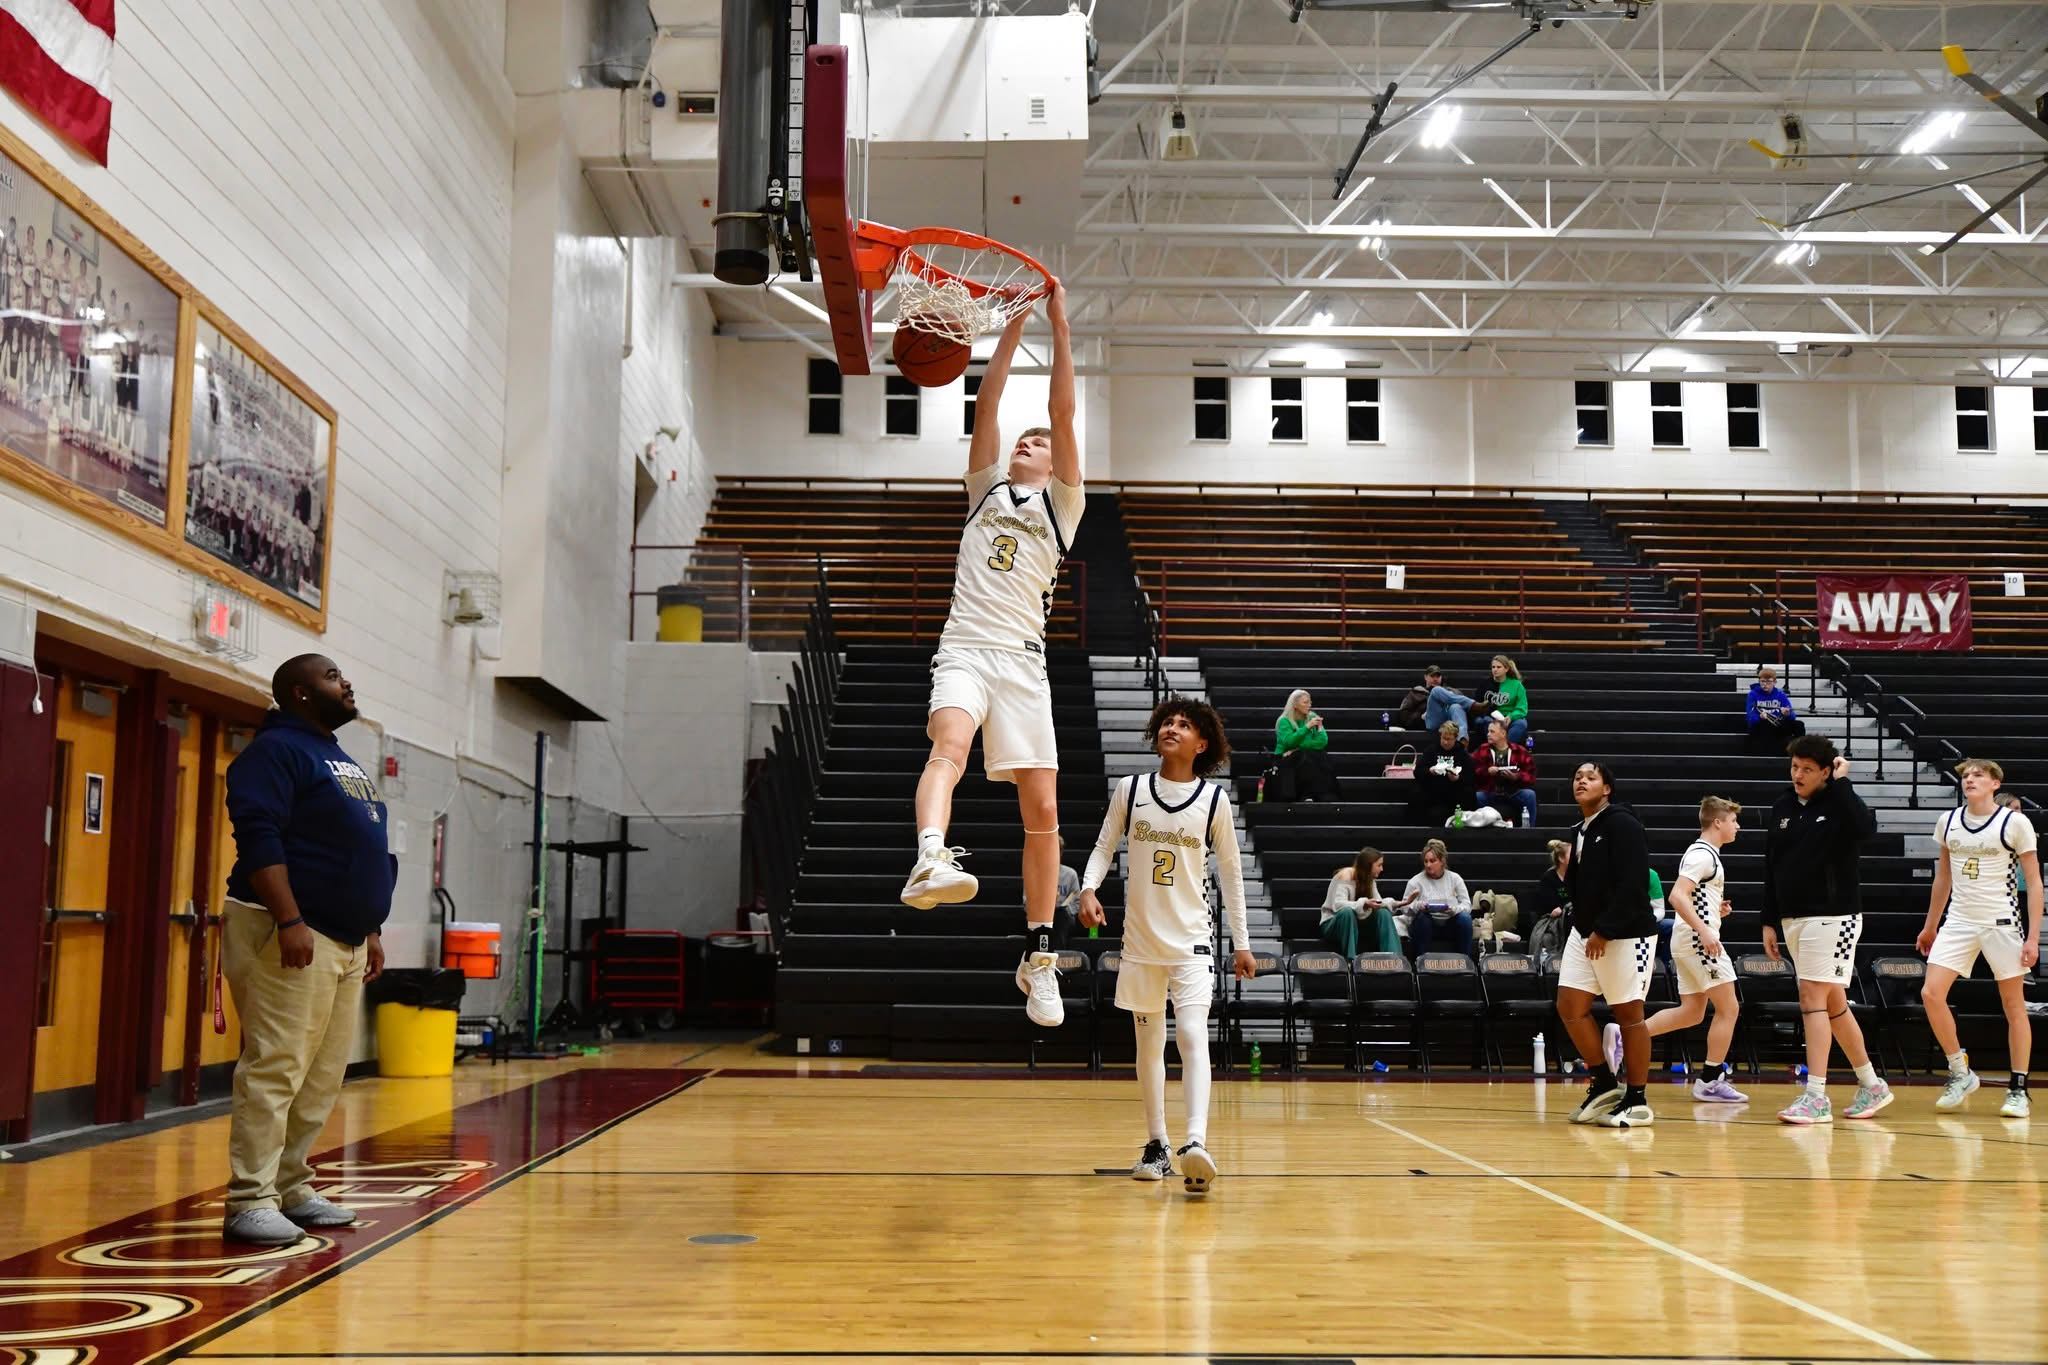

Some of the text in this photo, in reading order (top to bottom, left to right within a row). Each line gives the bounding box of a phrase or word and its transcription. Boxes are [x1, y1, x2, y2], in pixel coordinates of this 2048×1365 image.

[988, 535, 1018, 572] 3
[2007, 576, 2018, 584] 10
[1827, 591, 1960, 634] AWAY
[1134, 820, 1201, 849] Bourbon
[1153, 849, 1176, 886] 2
[1961, 857, 1980, 880] 4
[1298, 958, 1340, 970] COLONELS
[1361, 958, 1403, 970] COLONELS
[1424, 958, 1467, 970] COLONELS
[1487, 959, 1529, 971] COLONELS
[1744, 960, 1786, 972] COLONELS
[1881, 963, 1923, 975] COLONELS
